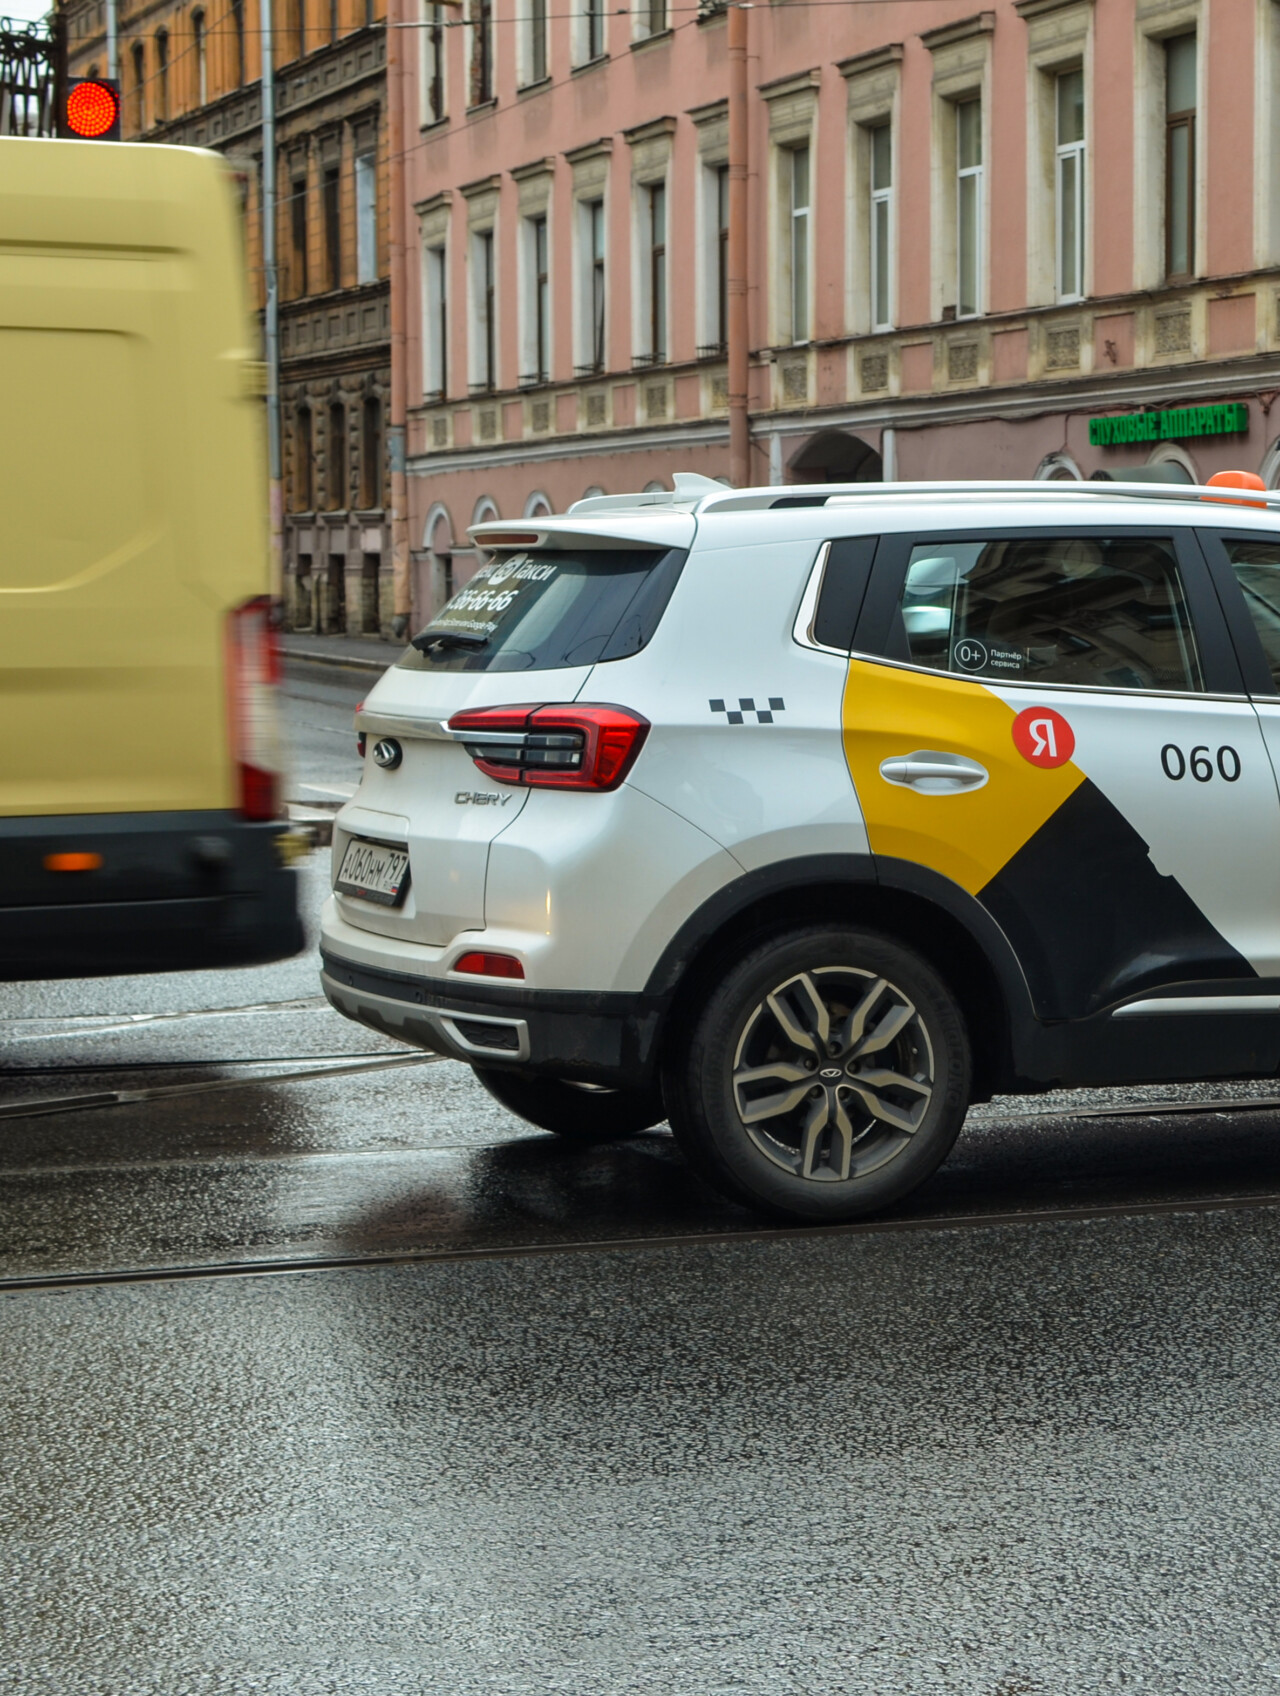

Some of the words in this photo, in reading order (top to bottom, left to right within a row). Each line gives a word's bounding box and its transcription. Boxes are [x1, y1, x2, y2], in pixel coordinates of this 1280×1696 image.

[1089, 411, 1157, 446] СЛУХОВЫЕ
[1160, 403, 1238, 440] АППАРАТЫ
[512, 559, 558, 581] Такси
[960, 645, 982, 662] 0+
[990, 648, 1022, 661] Партнёр
[990, 659, 1020, 669] сервиса
[1028, 718, 1058, 757] Я
[1160, 743, 1242, 783] 060
[454, 790, 513, 806] CHERY
[383, 852, 409, 881] 797
